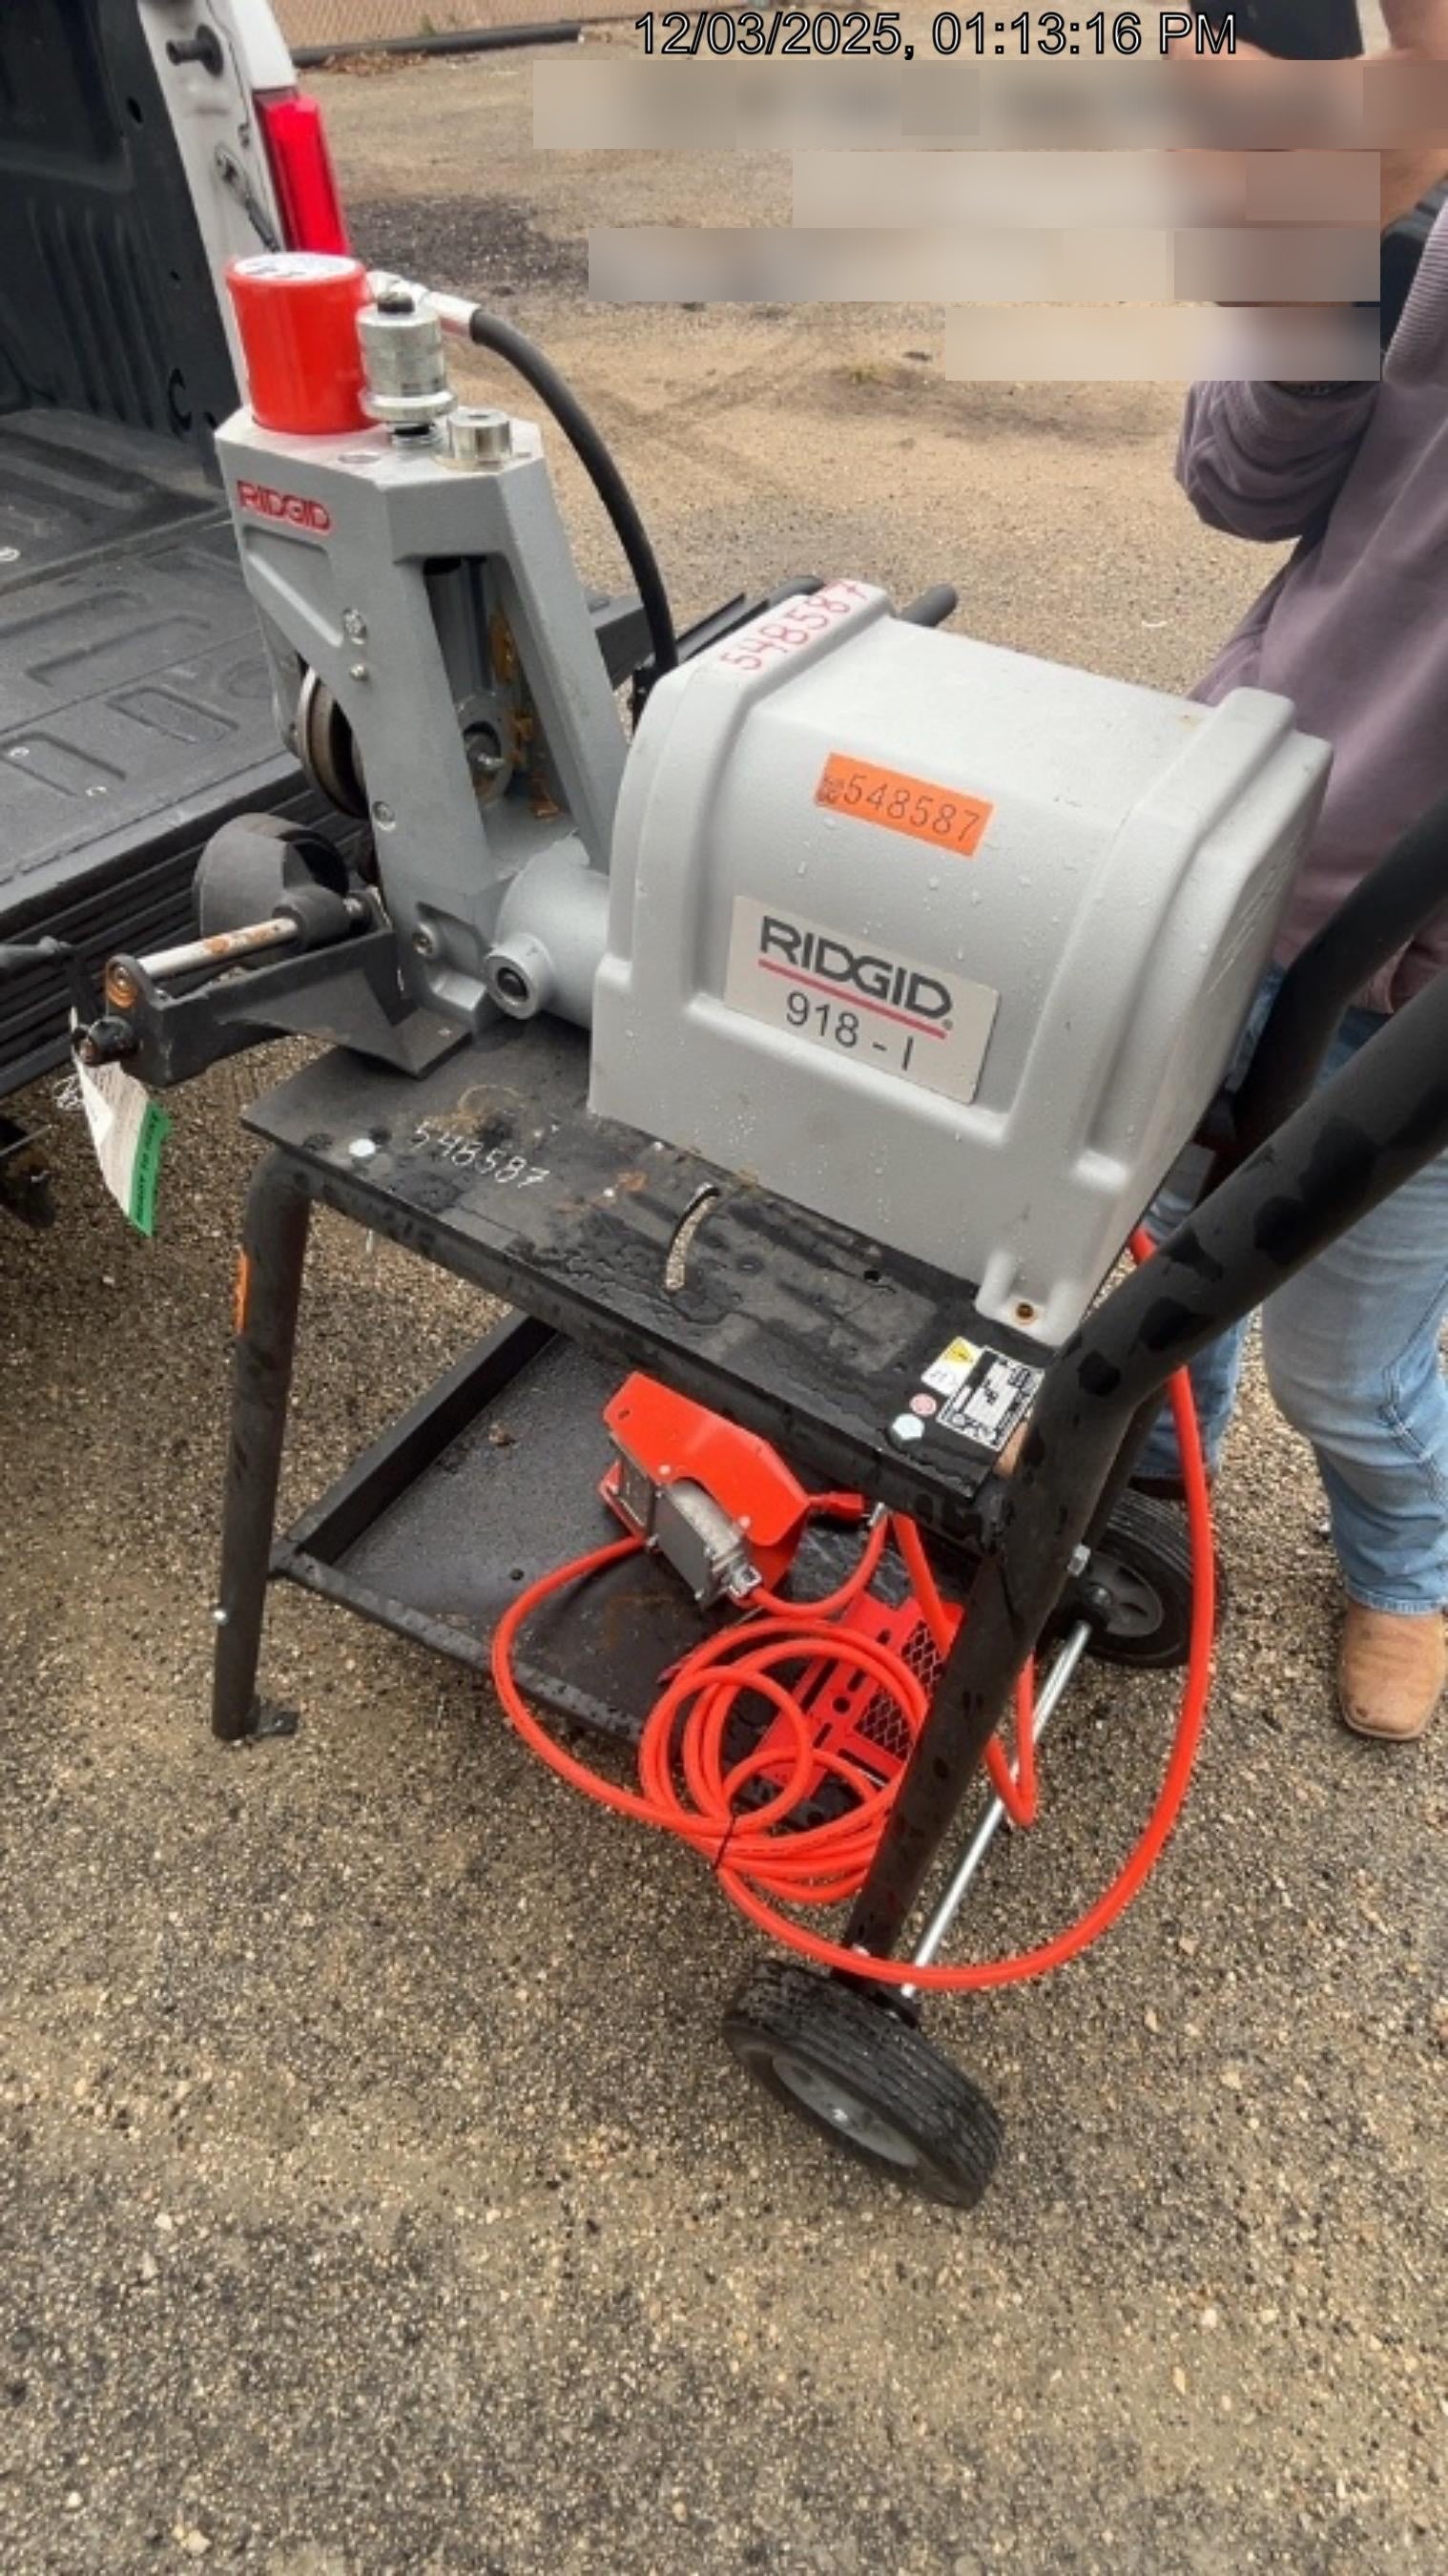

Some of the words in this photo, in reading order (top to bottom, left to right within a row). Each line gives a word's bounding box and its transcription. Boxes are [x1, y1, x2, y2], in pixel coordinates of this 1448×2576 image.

[237, 480, 330, 530] RIDGID
[720, 580, 867, 670] 548587
[844, 773, 981, 841] 548587
[760, 915, 953, 1020] RIDGID
[787, 991, 859, 1048] 918
[411, 1121, 550, 1189] 548587
